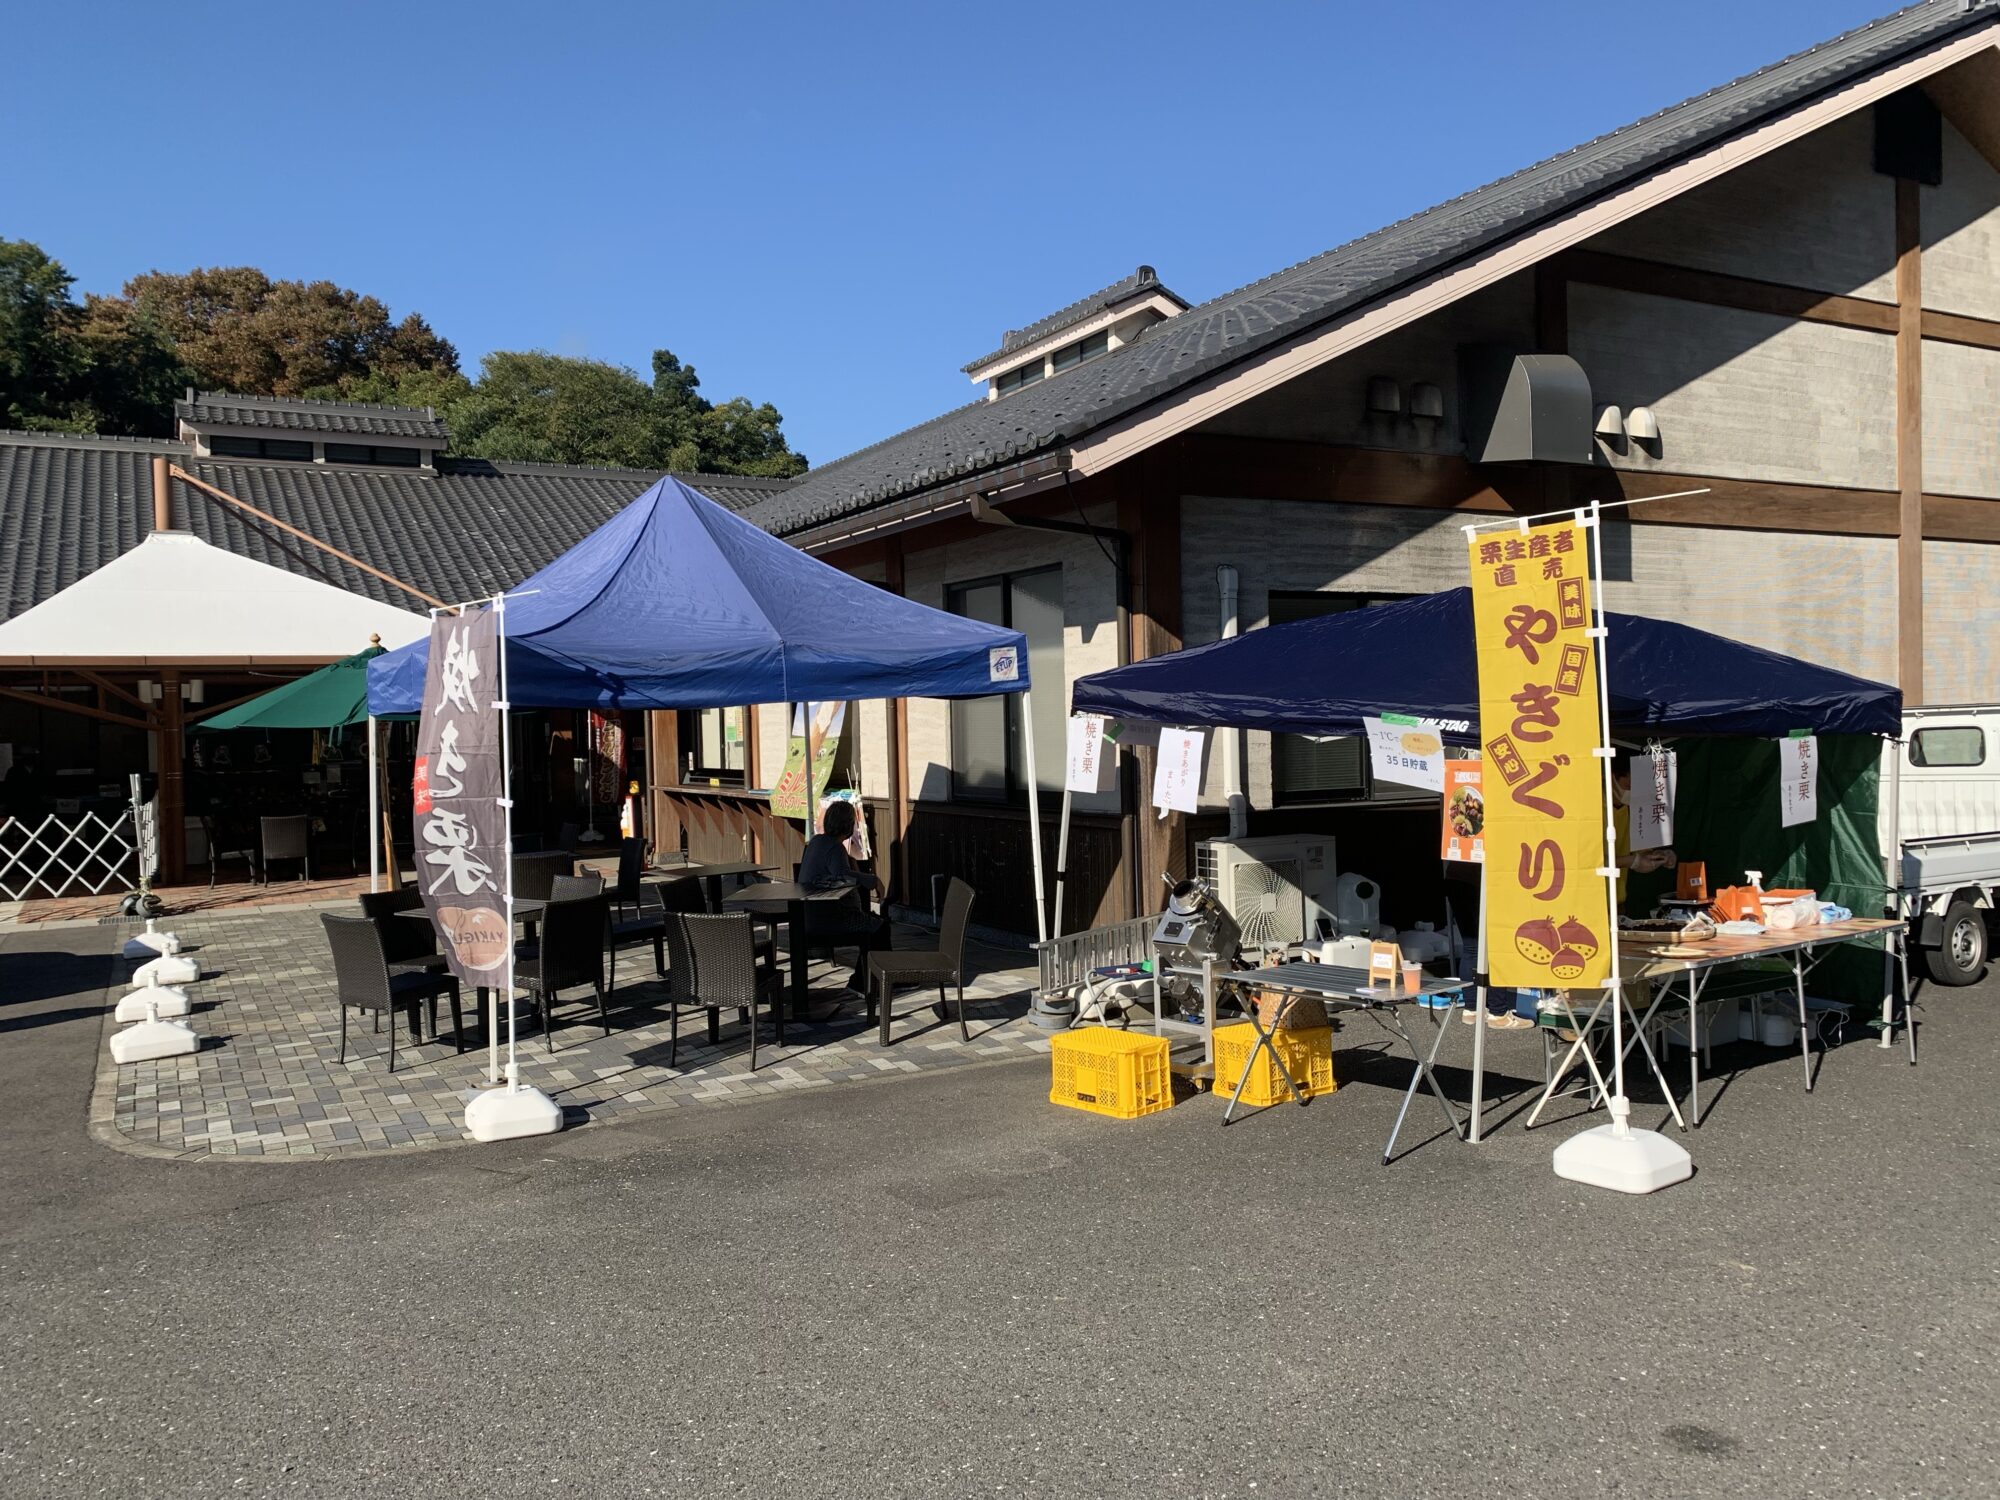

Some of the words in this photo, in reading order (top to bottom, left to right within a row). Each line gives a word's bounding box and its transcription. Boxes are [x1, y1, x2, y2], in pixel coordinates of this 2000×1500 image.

[1479, 529, 1575, 565] 栗生産者
[1563, 583, 1584, 624] 美味
[1559, 649, 1583, 689] 国産
[1439, 718, 1470, 732] STAG
[1081, 721, 1097, 774] 焼き栗
[1494, 742, 1520, 777] 安心
[1503, 604, 1571, 902] やきぐり
[1798, 739, 1811, 801] 焼き栗
[1652, 758, 1668, 825] 焼き栗
